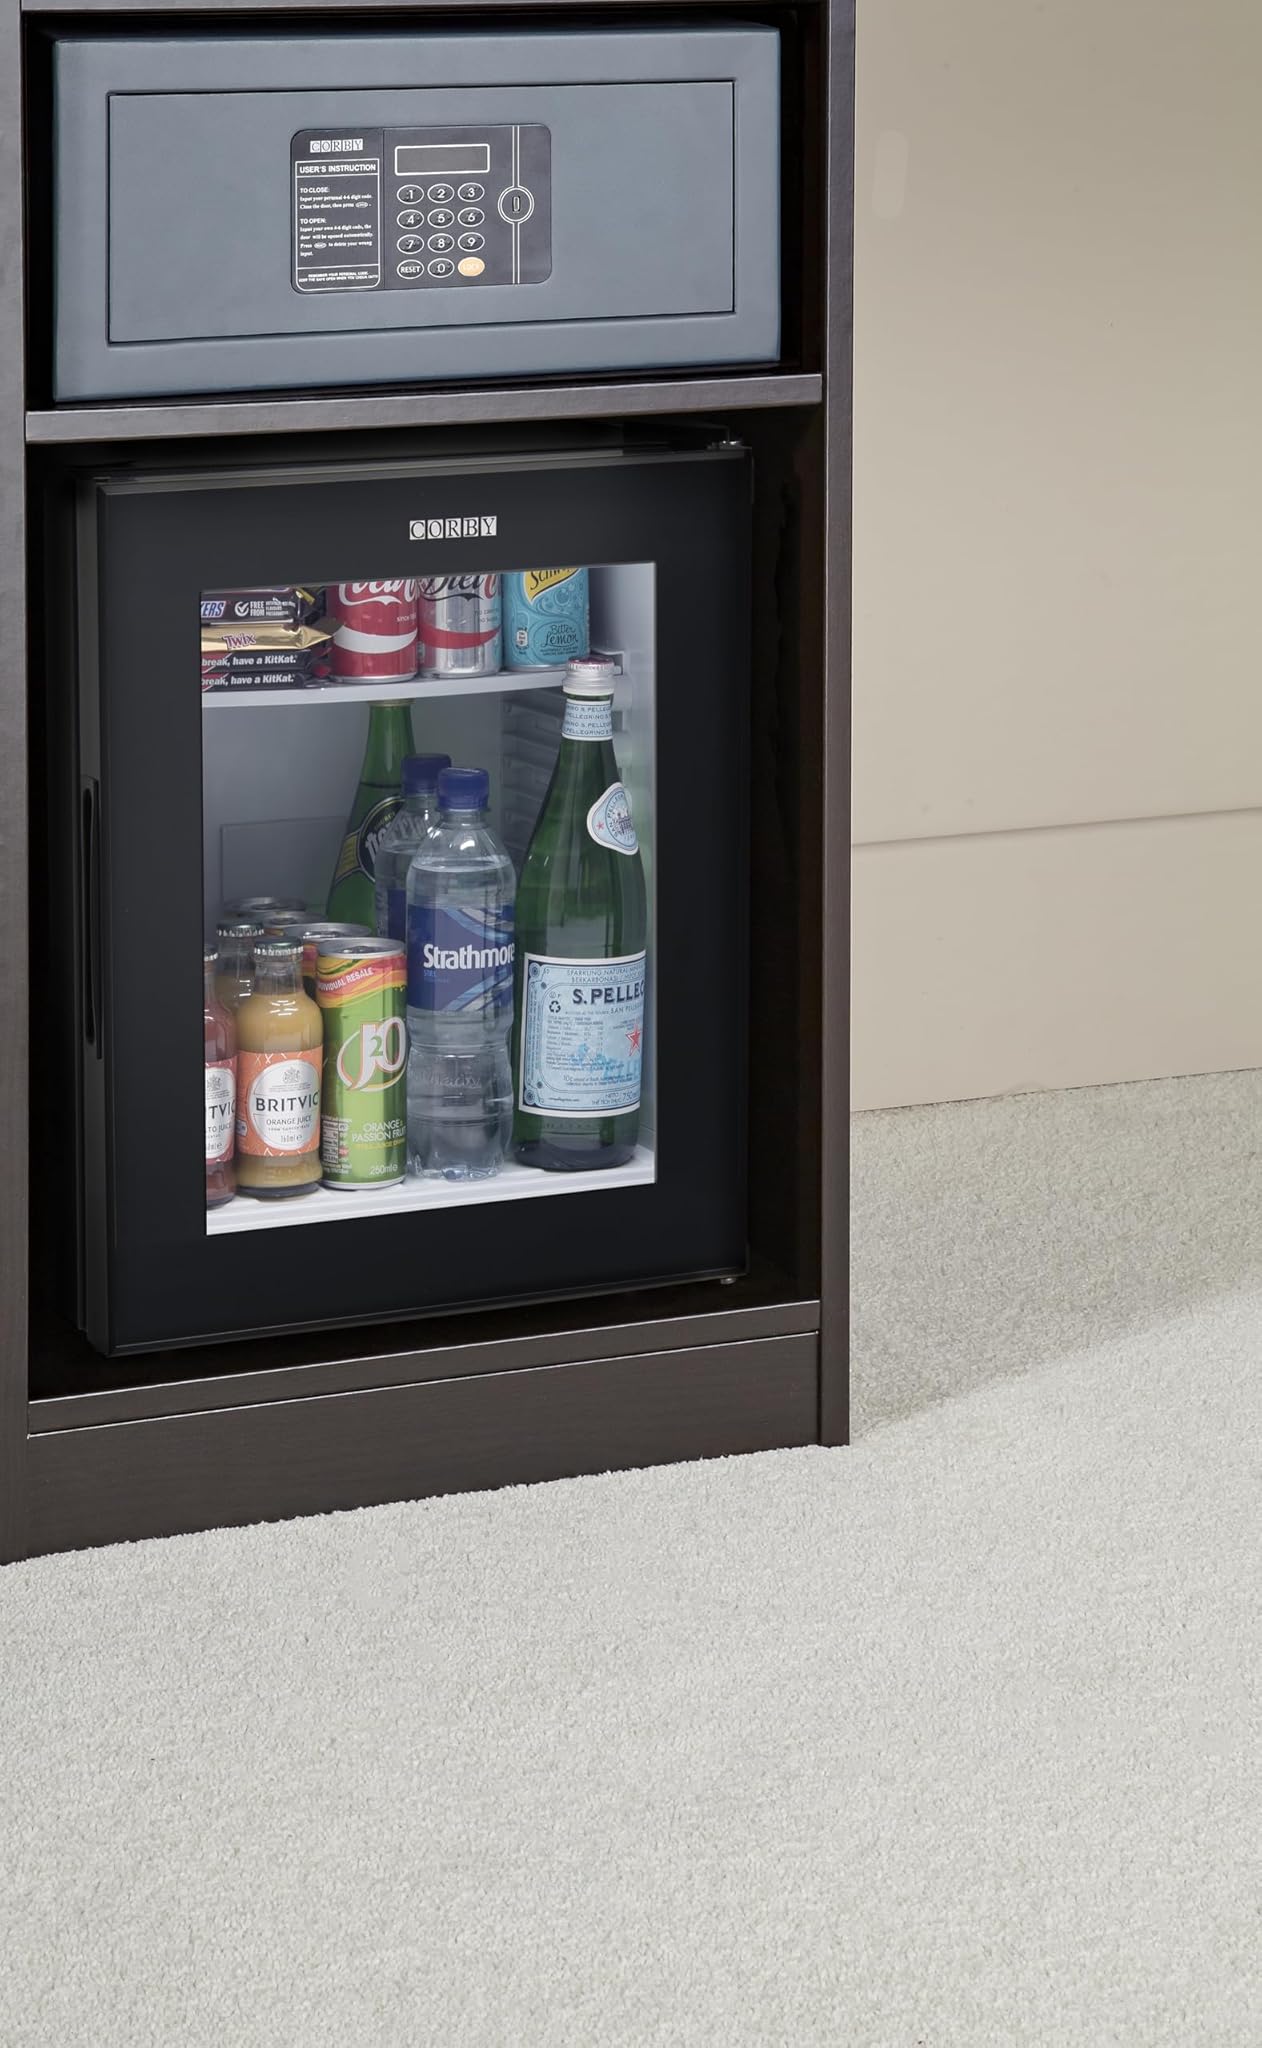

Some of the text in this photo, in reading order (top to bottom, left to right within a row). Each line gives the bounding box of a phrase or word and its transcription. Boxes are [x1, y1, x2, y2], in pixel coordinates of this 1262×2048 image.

[310, 139, 363, 153] CORBY
[300, 163, 376, 174] USER'S INSTRUCTION
[408, 187, 475, 199] 1 2 3
[407, 212, 475, 224] 4 5 6
[407, 237, 475, 249] 7 8 9
[400, 263, 446, 274] RESET 0
[410, 516, 497, 540] CORBY
[249, 601, 264, 609] FREE
[224, 634, 256, 649] Twix
[232, 657, 255, 666] have
[230, 673, 252, 684] have
[423, 942, 515, 970] Strathmore
[346, 966, 374, 984] RESALE
[255, 1090, 319, 1112] BRITVIC
[266, 1114, 312, 1126] ORANGE JUICE
[362, 1118, 400, 1132] ORANGE
[351, 1131, 392, 1143] PASSION
